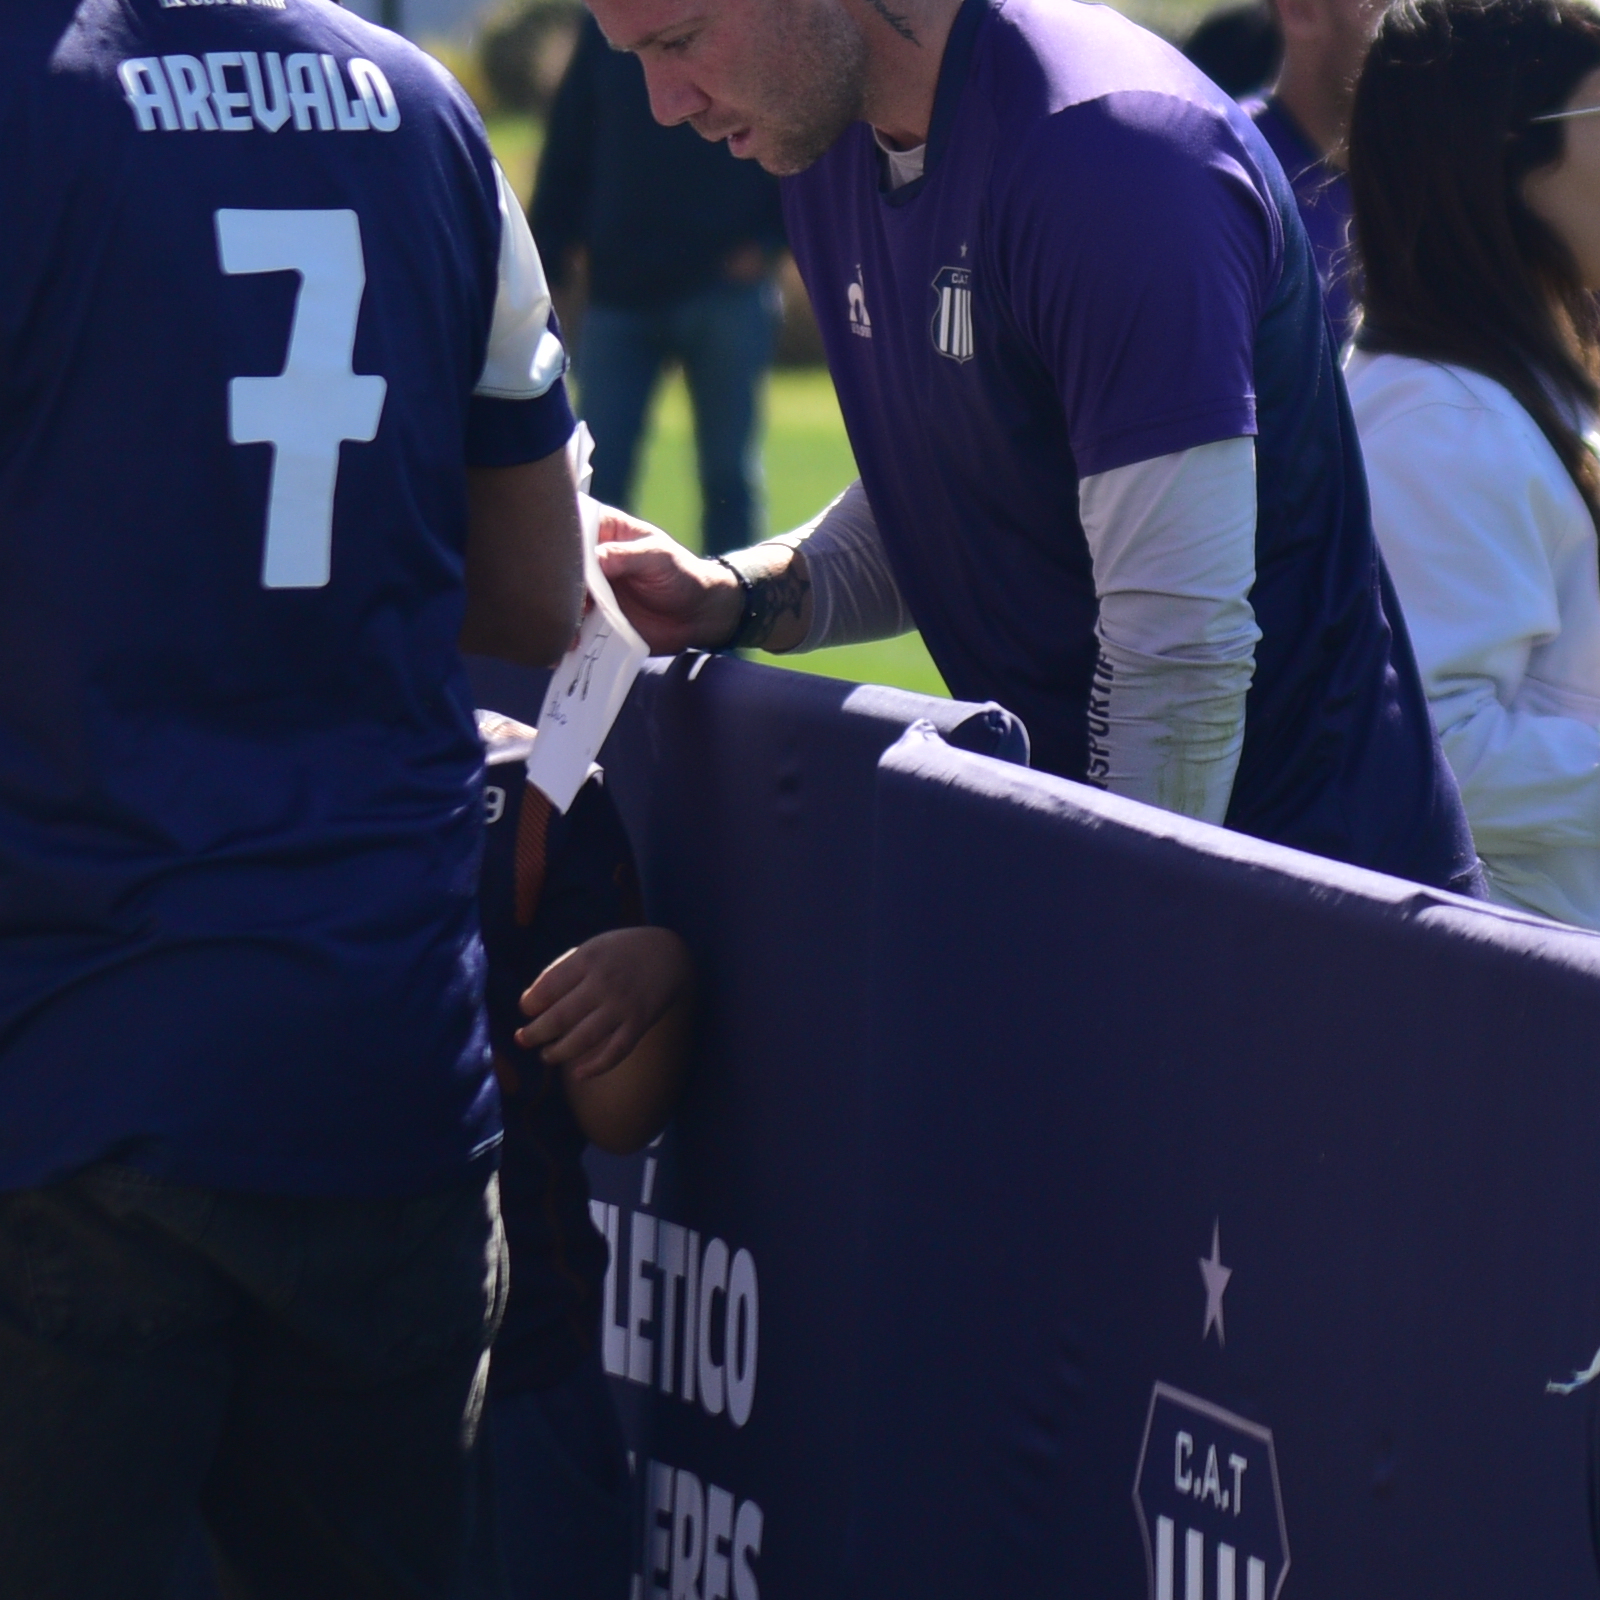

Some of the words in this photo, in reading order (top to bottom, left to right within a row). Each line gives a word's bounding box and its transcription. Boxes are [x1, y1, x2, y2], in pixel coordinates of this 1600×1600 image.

[117, 50, 401, 133] AREVALO
[214, 208, 388, 589] 7
[1174, 1430, 1248, 1517] C.A.T
